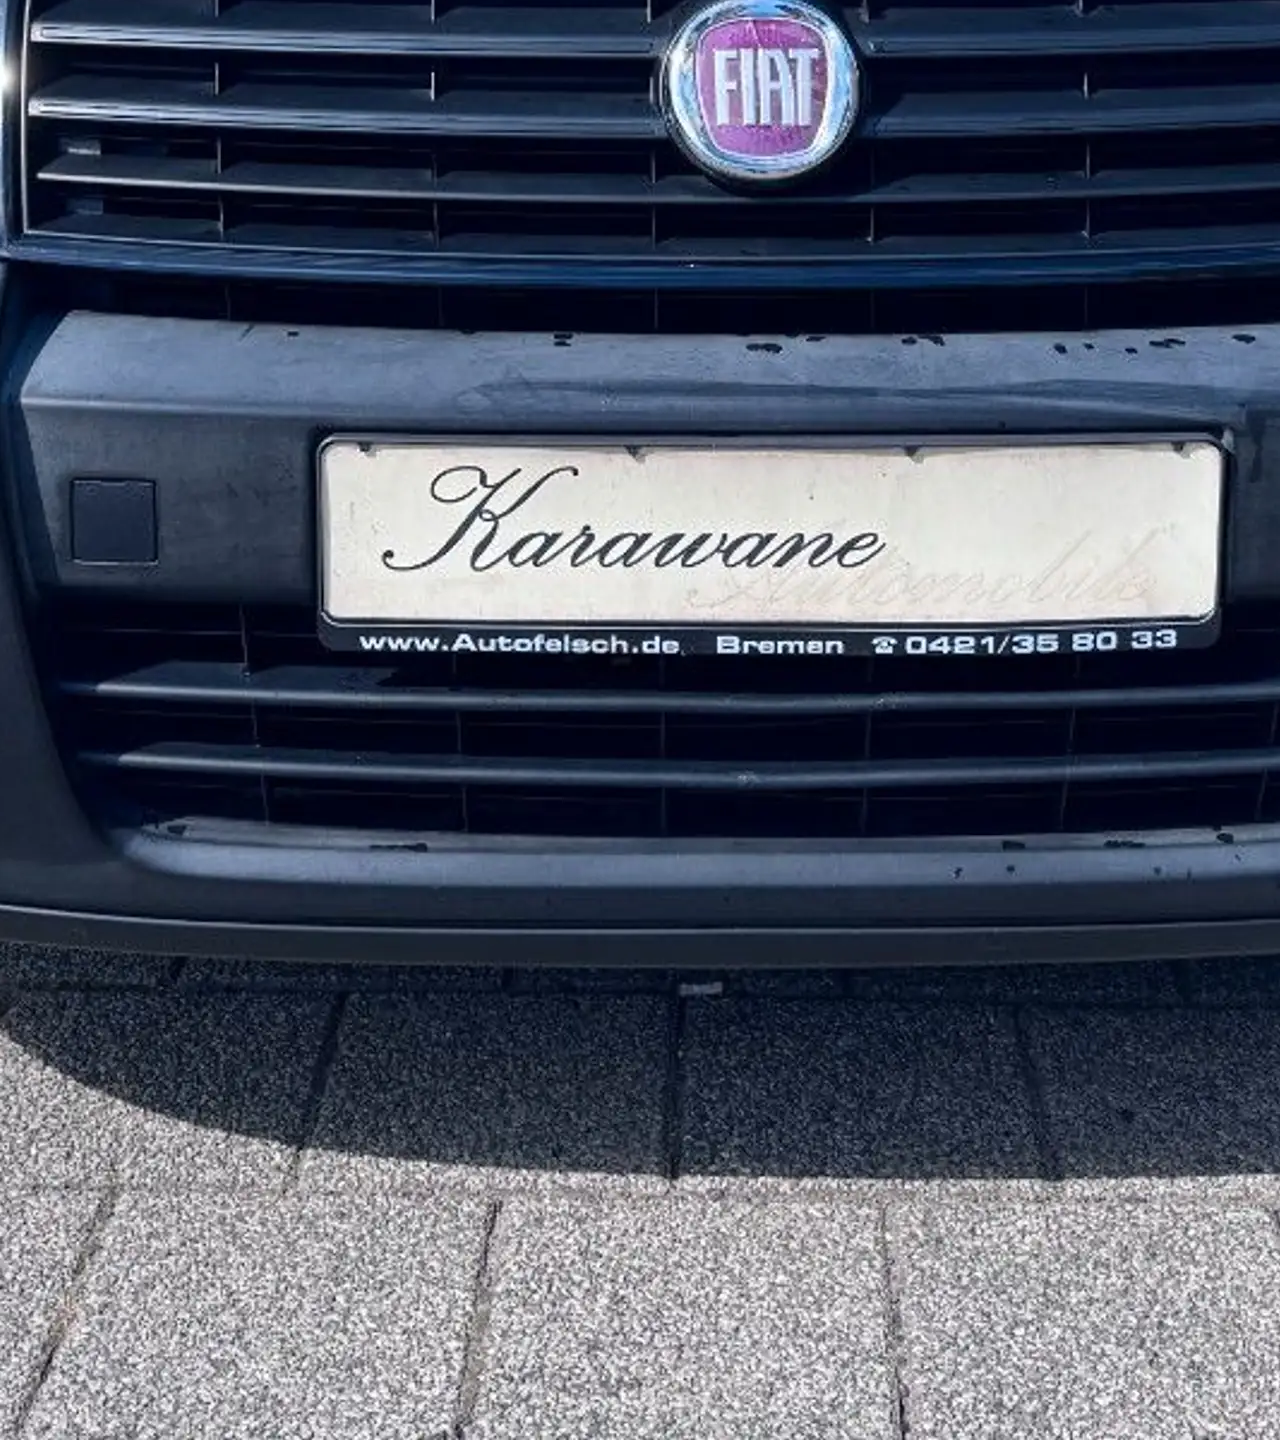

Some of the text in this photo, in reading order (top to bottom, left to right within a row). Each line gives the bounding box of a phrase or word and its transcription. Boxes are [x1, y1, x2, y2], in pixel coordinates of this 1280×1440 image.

[713, 47, 819, 127] FIAT
[380, 464, 887, 573] Karawane
[715, 634, 844, 656] Bremen
[904, 631, 1060, 656] 0421/35
[1071, 631, 1118, 652] 80
[1130, 629, 1179, 650] 33
